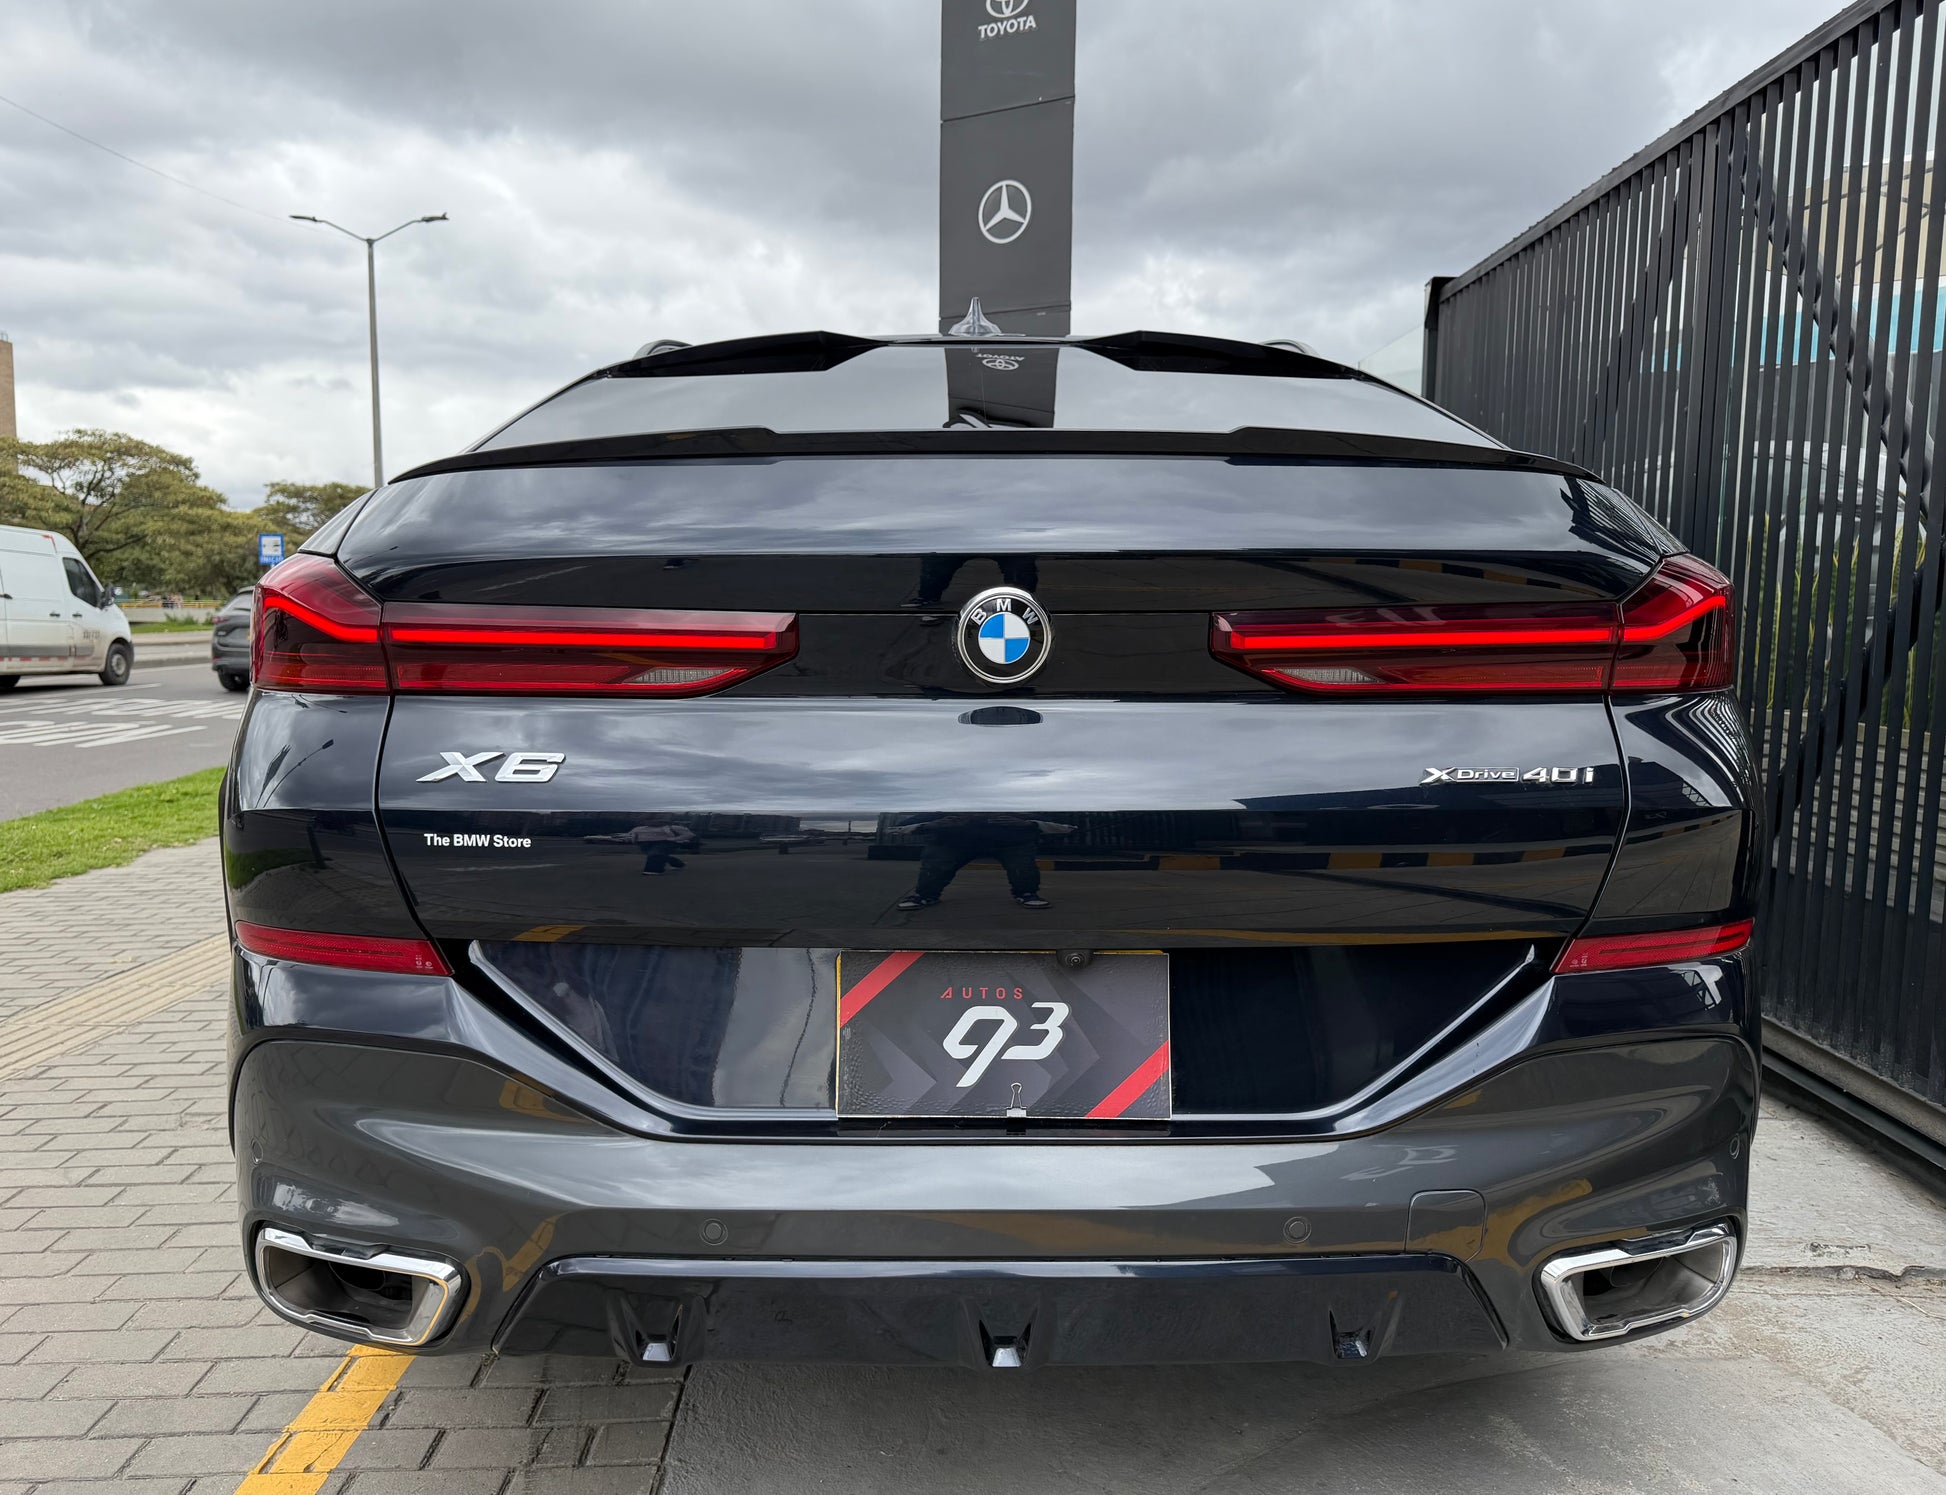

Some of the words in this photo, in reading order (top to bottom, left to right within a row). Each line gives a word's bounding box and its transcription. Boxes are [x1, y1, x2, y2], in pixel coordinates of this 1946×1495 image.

[978, 15, 1036, 38] TOYOTA
[971, 598, 1038, 625] BMW
[416, 752, 566, 783] X6
[424, 833, 450, 847] The
[453, 834, 490, 847] BMW
[493, 835, 531, 848] Store
[940, 987, 1023, 999] AUTOS
[943, 1002, 1069, 1088] 93
